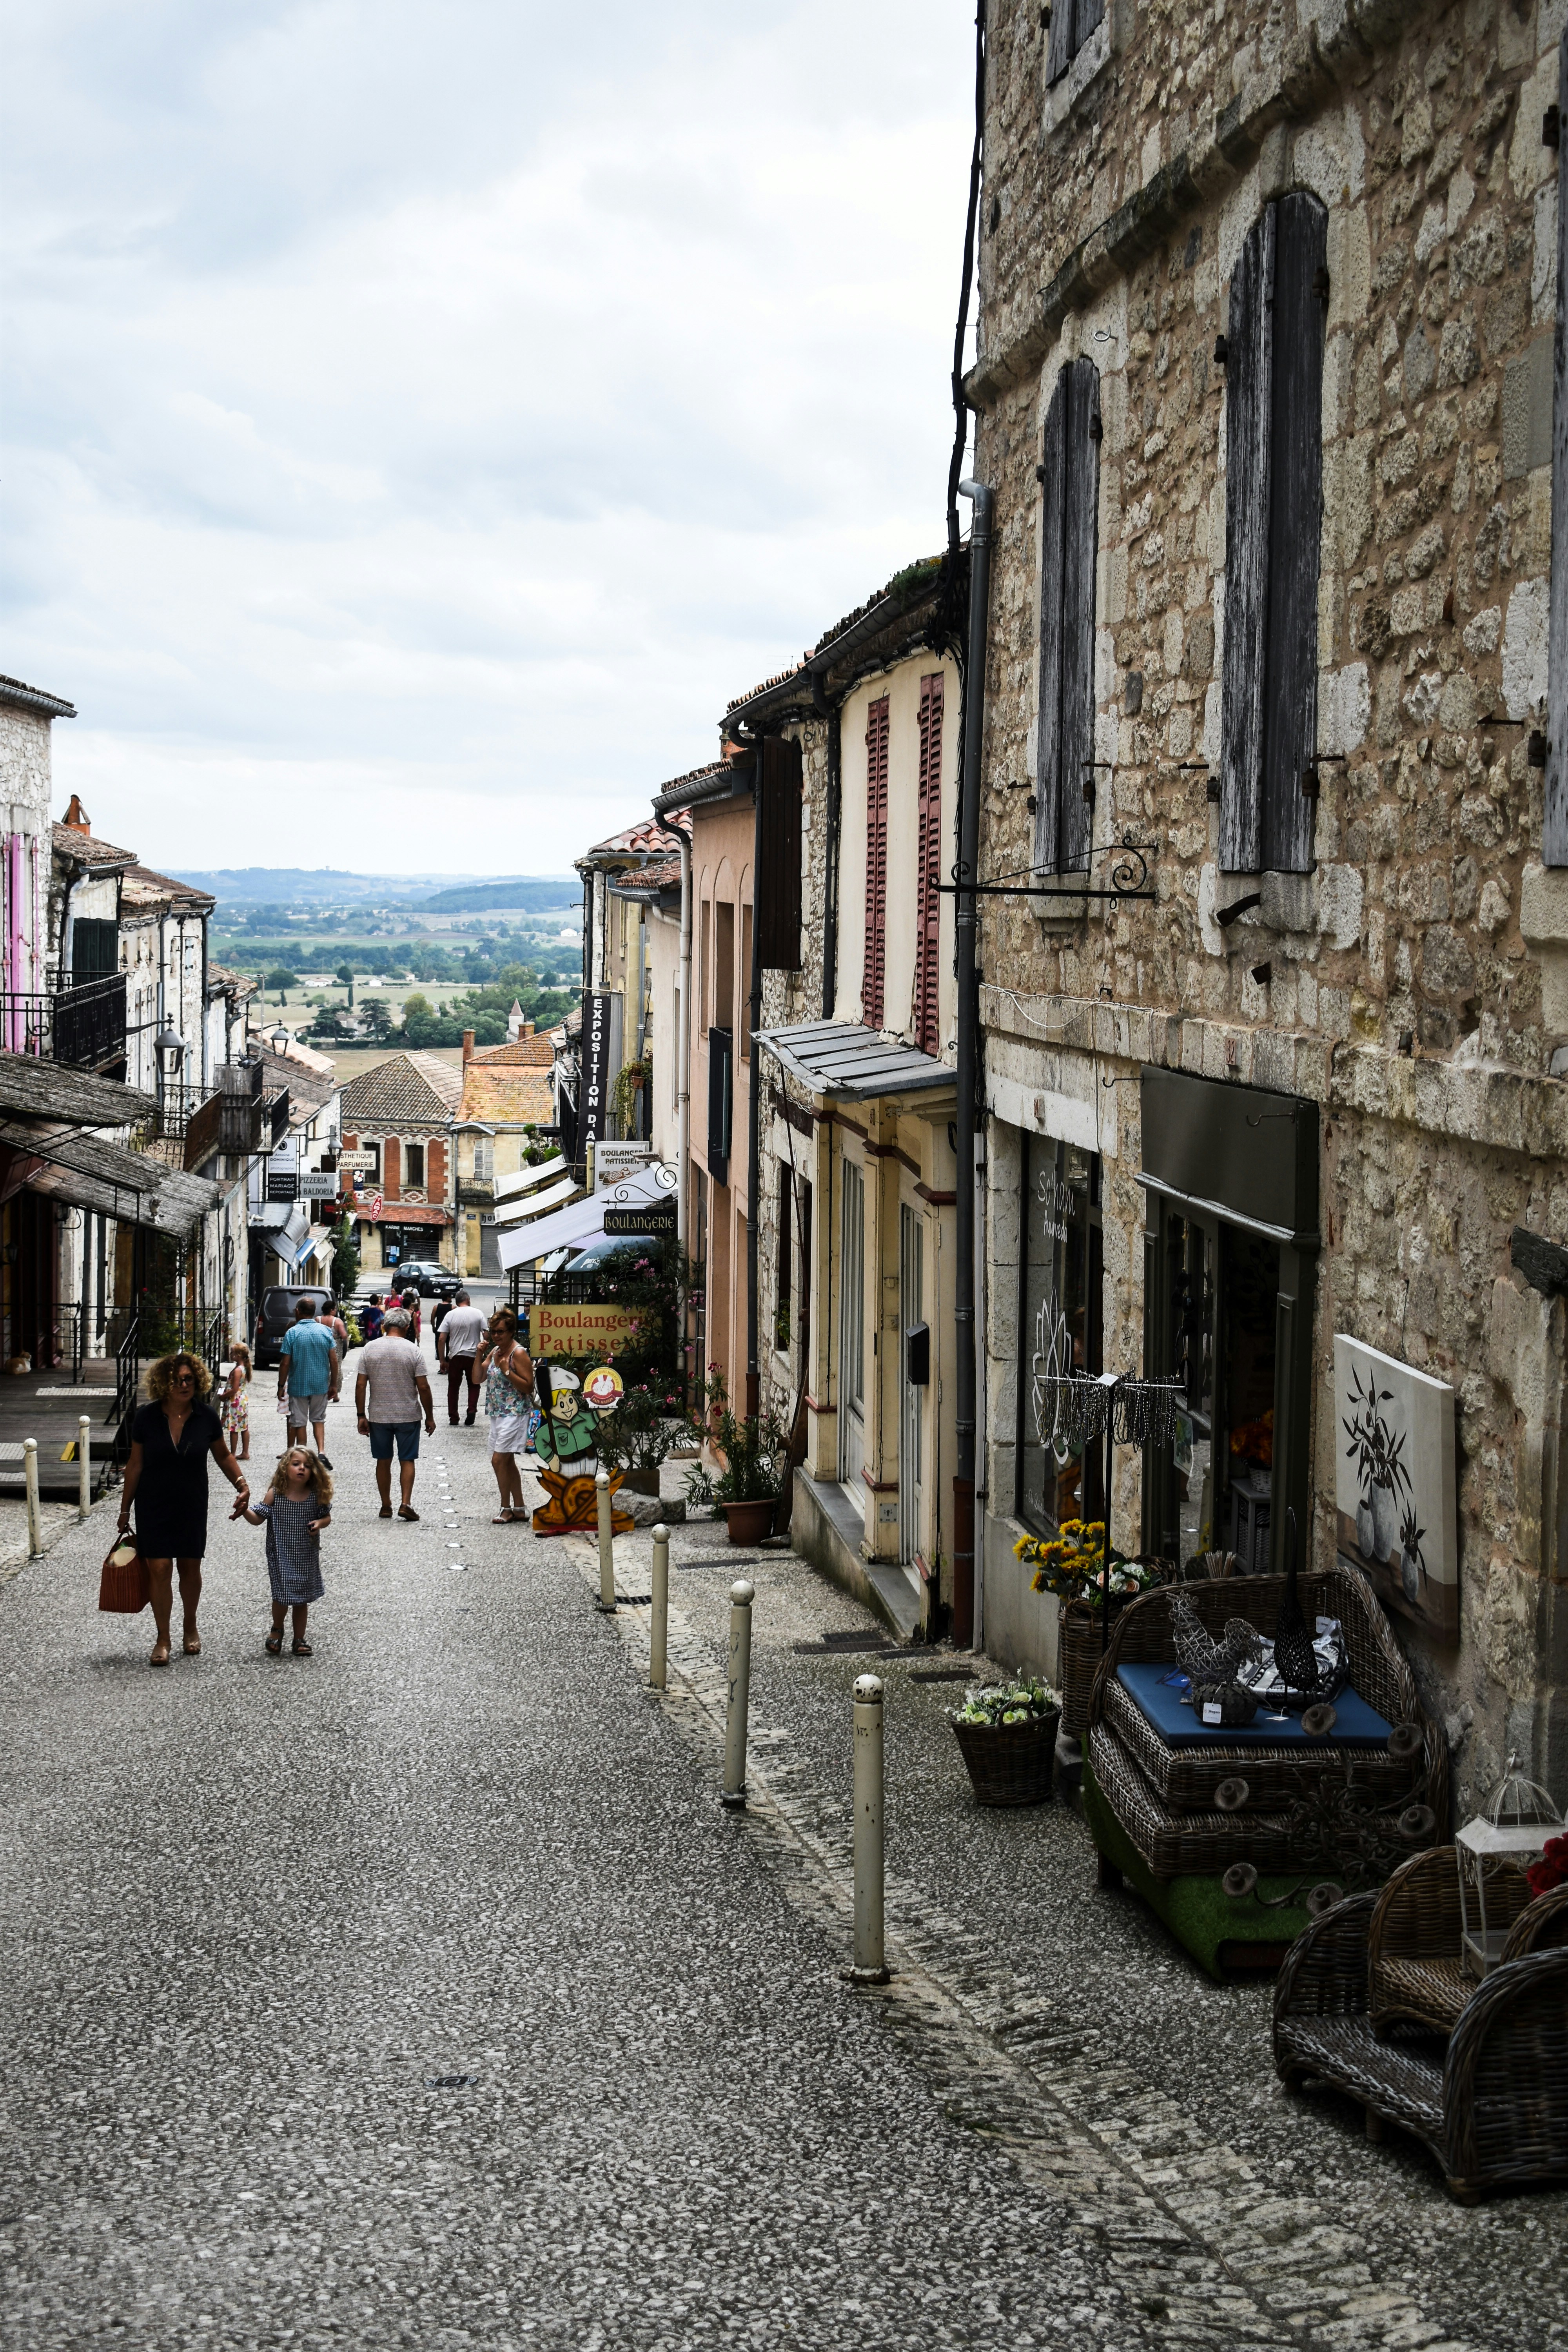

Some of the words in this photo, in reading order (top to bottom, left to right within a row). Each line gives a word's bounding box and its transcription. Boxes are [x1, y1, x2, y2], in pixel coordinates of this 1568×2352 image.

[588, 998, 603, 1106] EXPOSITION
[1226, 1040, 1234, 1063] 32
[585, 1114, 597, 1154] D'AR
[373, 1197, 382, 1218] TABAC
[1044, 1210, 1067, 1243] Ayurveda
